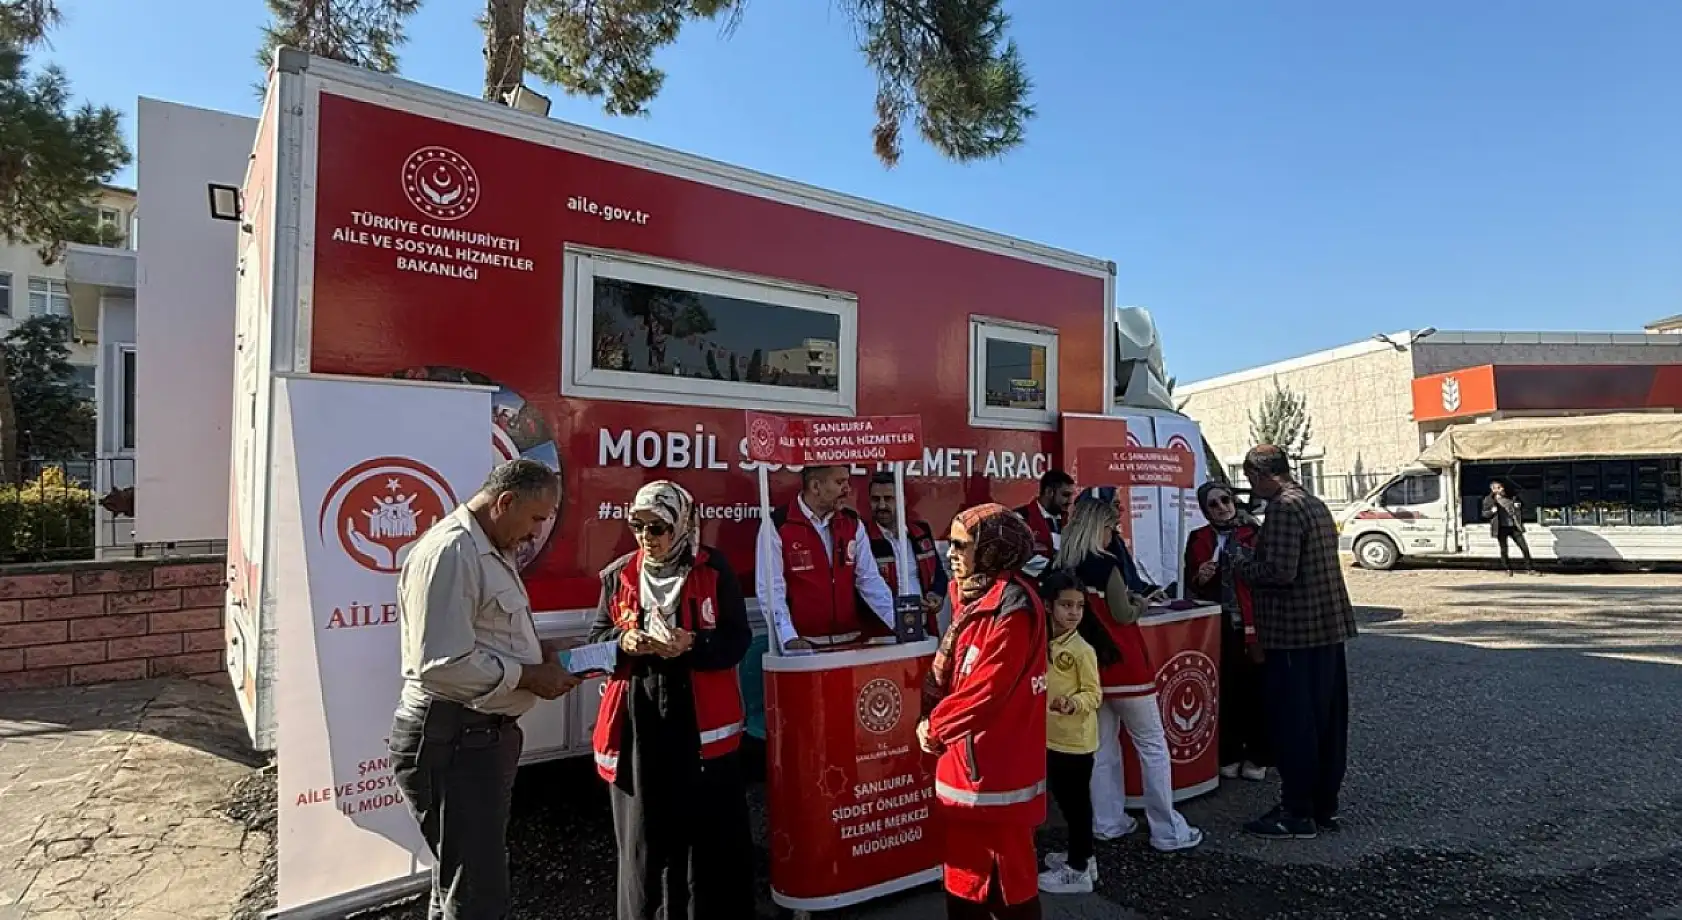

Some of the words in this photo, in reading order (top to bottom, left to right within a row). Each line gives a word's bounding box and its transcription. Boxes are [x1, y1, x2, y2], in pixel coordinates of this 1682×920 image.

[567, 195, 651, 225] aile.gov.tr
[351, 211, 418, 234] TÜRKİYE
[421, 224, 520, 252] CUMHURİYETİ
[332, 227, 369, 245] AİLE
[372, 234, 393, 249] VE
[395, 238, 453, 259] SOSYAL
[456, 248, 534, 272] HİZMETLER
[396, 256, 478, 280] BAKANLIĞI
[798, 436, 810, 447] VE
[813, 435, 855, 446] SOSYAL
[857, 433, 915, 444] HİZMETLER
[813, 420, 873, 434] ŞANLIURFA
[599, 424, 728, 469] MOBİL
[324, 601, 398, 629] AİLE
[296, 788, 331, 805] AİLE
[334, 782, 353, 798] VE
[357, 774, 396, 795] SOSY
[854, 774, 914, 799] ŞANLIURFA
[342, 802, 355, 815] İL
[359, 791, 404, 812] MÜDÜ
[832, 801, 874, 824] ŞİDDET
[877, 789, 920, 811] ÖNLEME
[921, 787, 933, 799] VE
[841, 819, 882, 839] İZLEME
[884, 804, 929, 829] MERKEZİ
[852, 826, 922, 857] MÜDÜRLÜĞÜ
